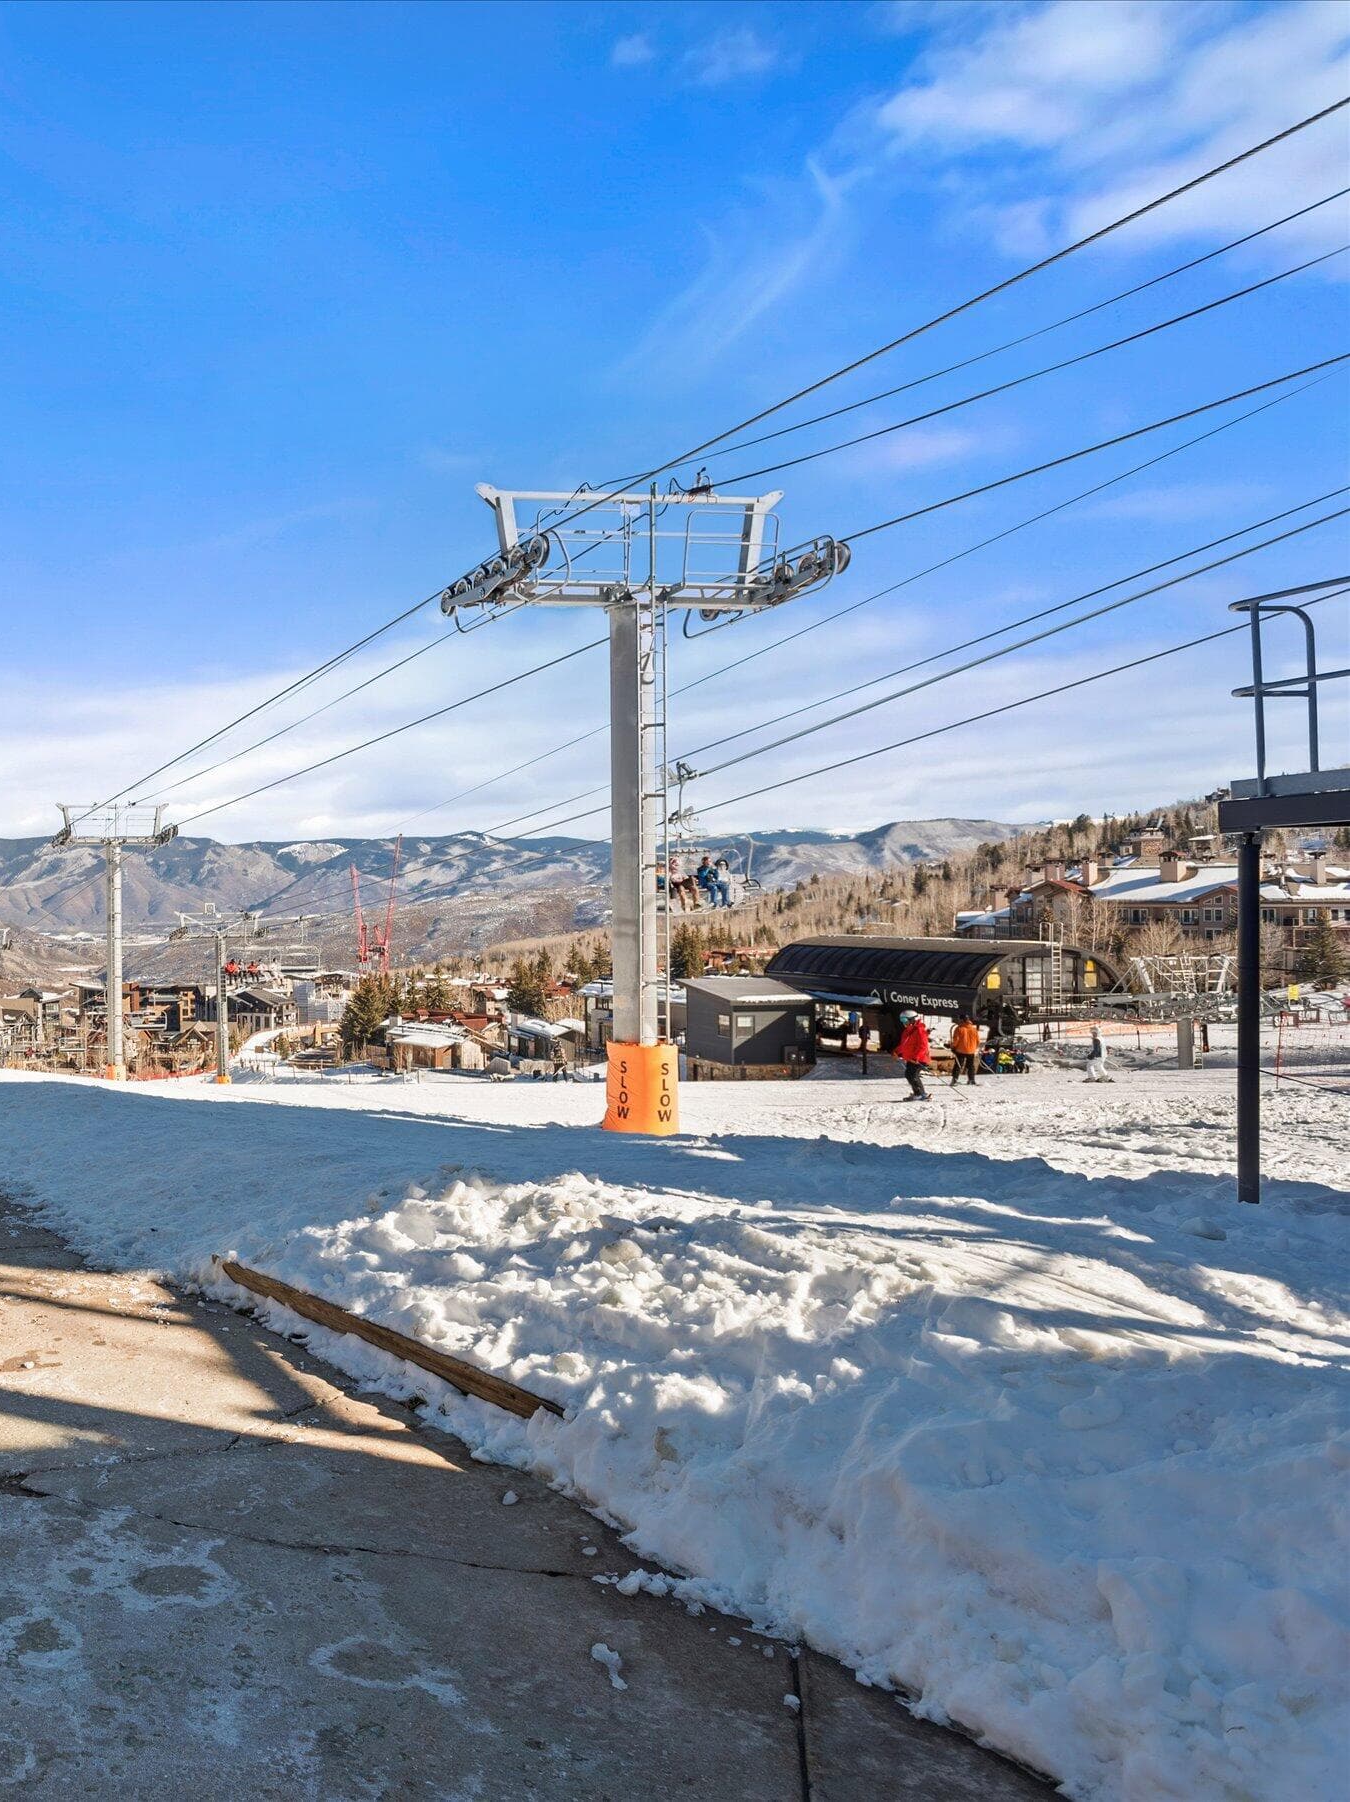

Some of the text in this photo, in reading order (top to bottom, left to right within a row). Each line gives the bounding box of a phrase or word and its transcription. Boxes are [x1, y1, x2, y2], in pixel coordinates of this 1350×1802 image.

[890, 991, 959, 1009] Coney Express
[617, 1060, 630, 1119] SLOW
[657, 1062, 671, 1122] SLOW
